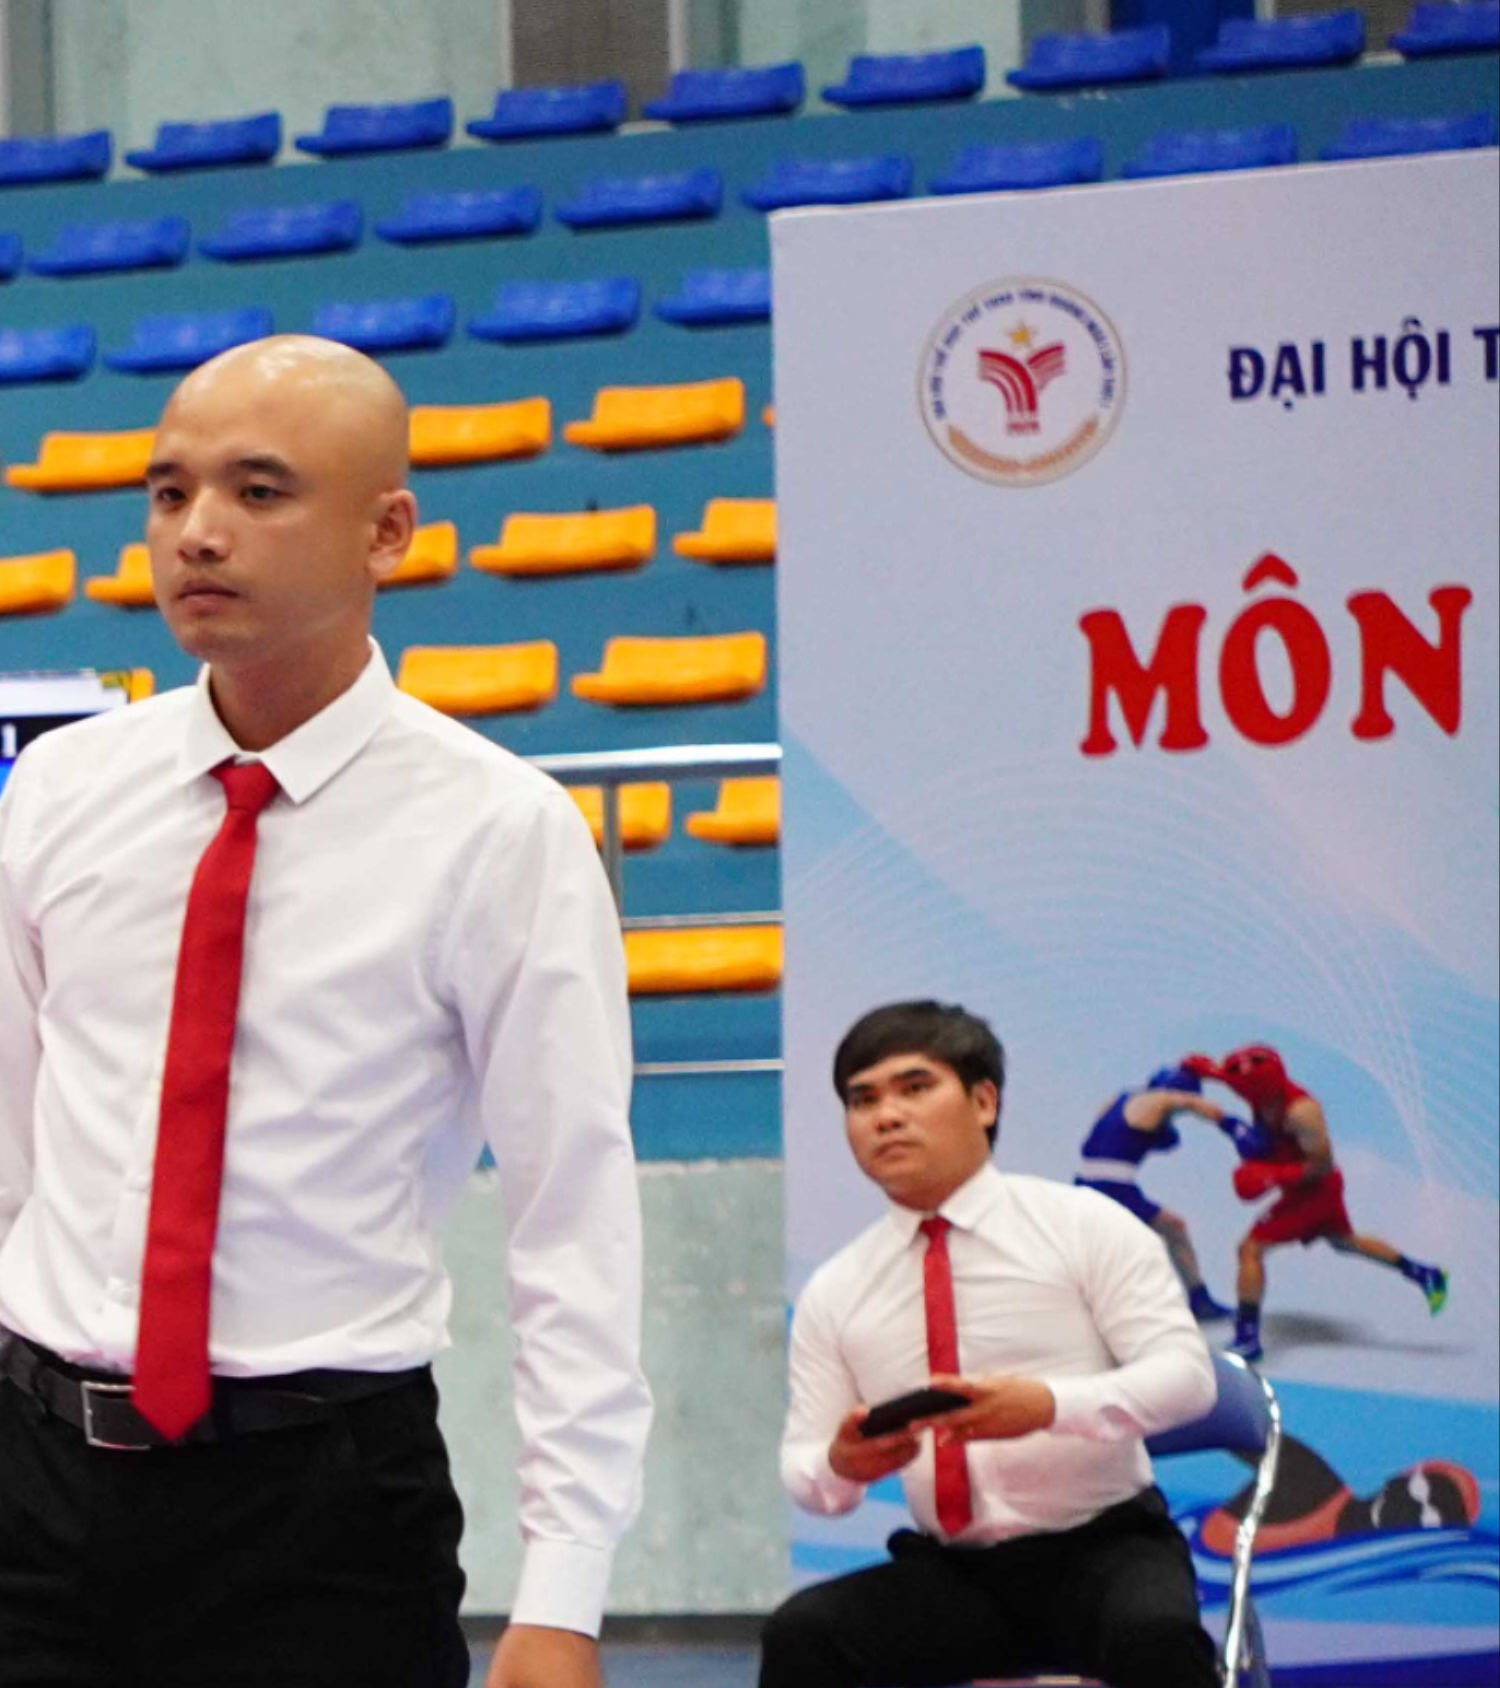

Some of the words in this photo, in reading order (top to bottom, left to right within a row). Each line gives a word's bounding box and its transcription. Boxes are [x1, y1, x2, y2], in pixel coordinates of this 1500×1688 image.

[1227, 340, 1326, 410] ĐẠI
[1351, 315, 1451, 401] HỘI
[1077, 550, 1474, 758] MÔN
